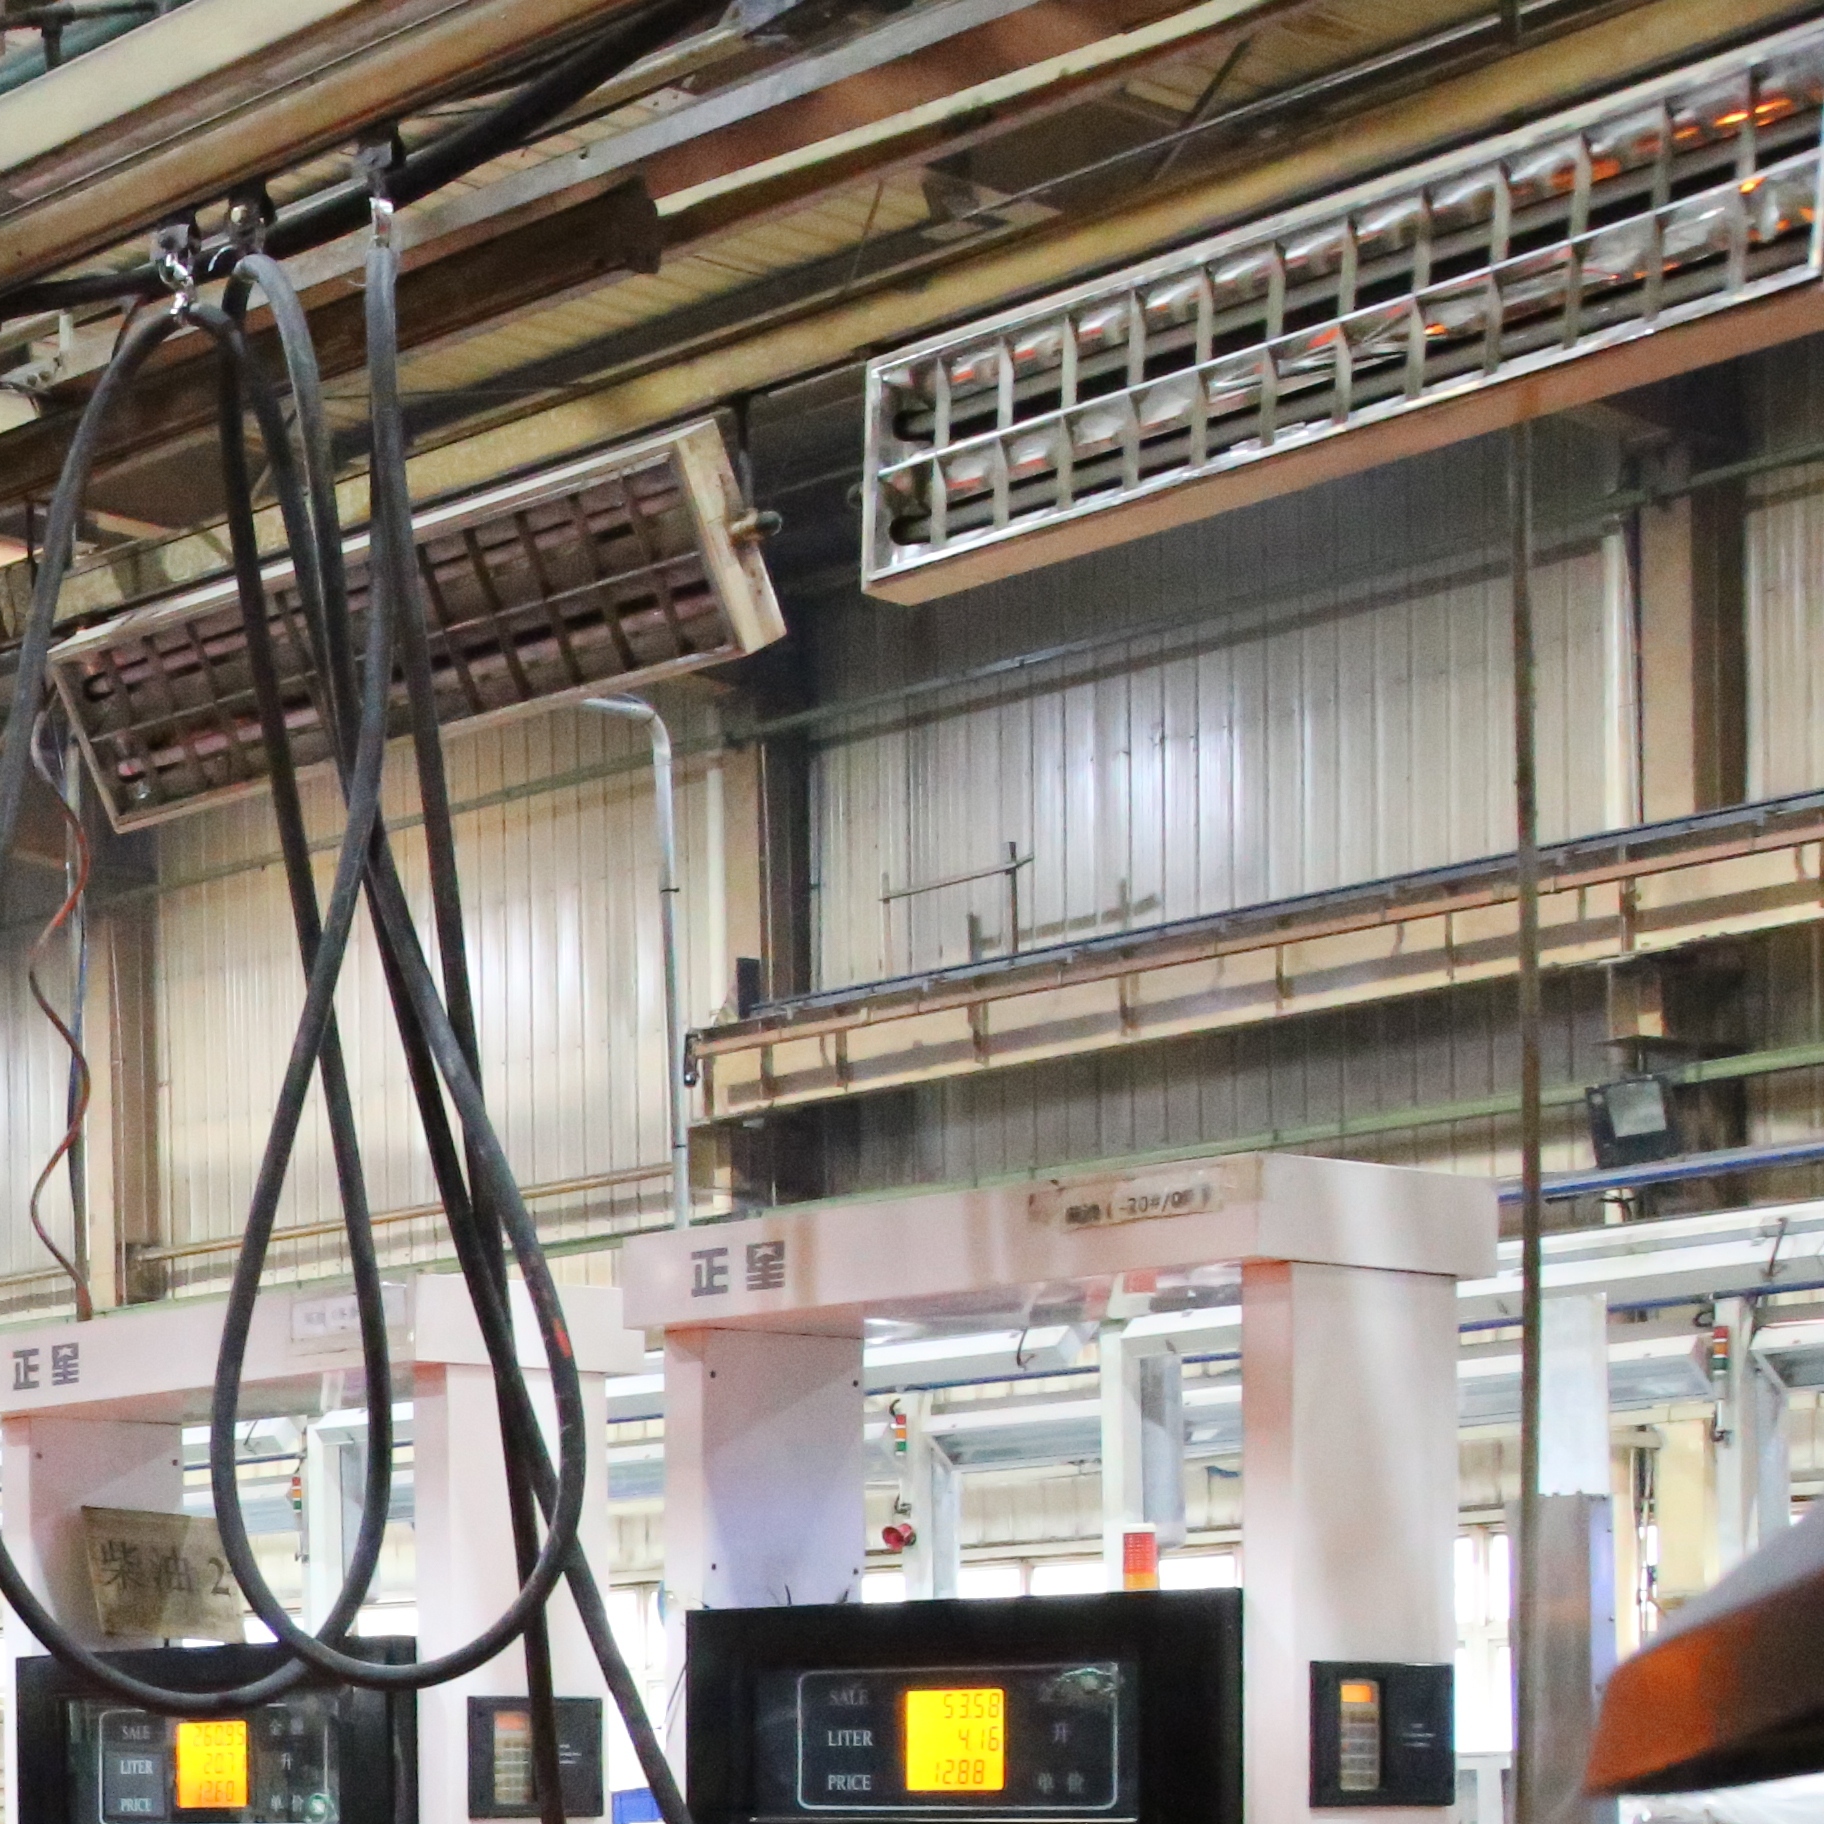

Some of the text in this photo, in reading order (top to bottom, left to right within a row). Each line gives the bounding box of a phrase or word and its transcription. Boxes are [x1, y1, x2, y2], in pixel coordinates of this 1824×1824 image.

[691, 1240, 785, 1297] 正星
[12, 1342, 79, 1390] 正星
[827, 1730, 873, 1748] LITER
[120, 1759, 153, 1775] LITER
[827, 1774, 871, 1791] PRICE
[120, 1798, 151, 1813] PRICE
